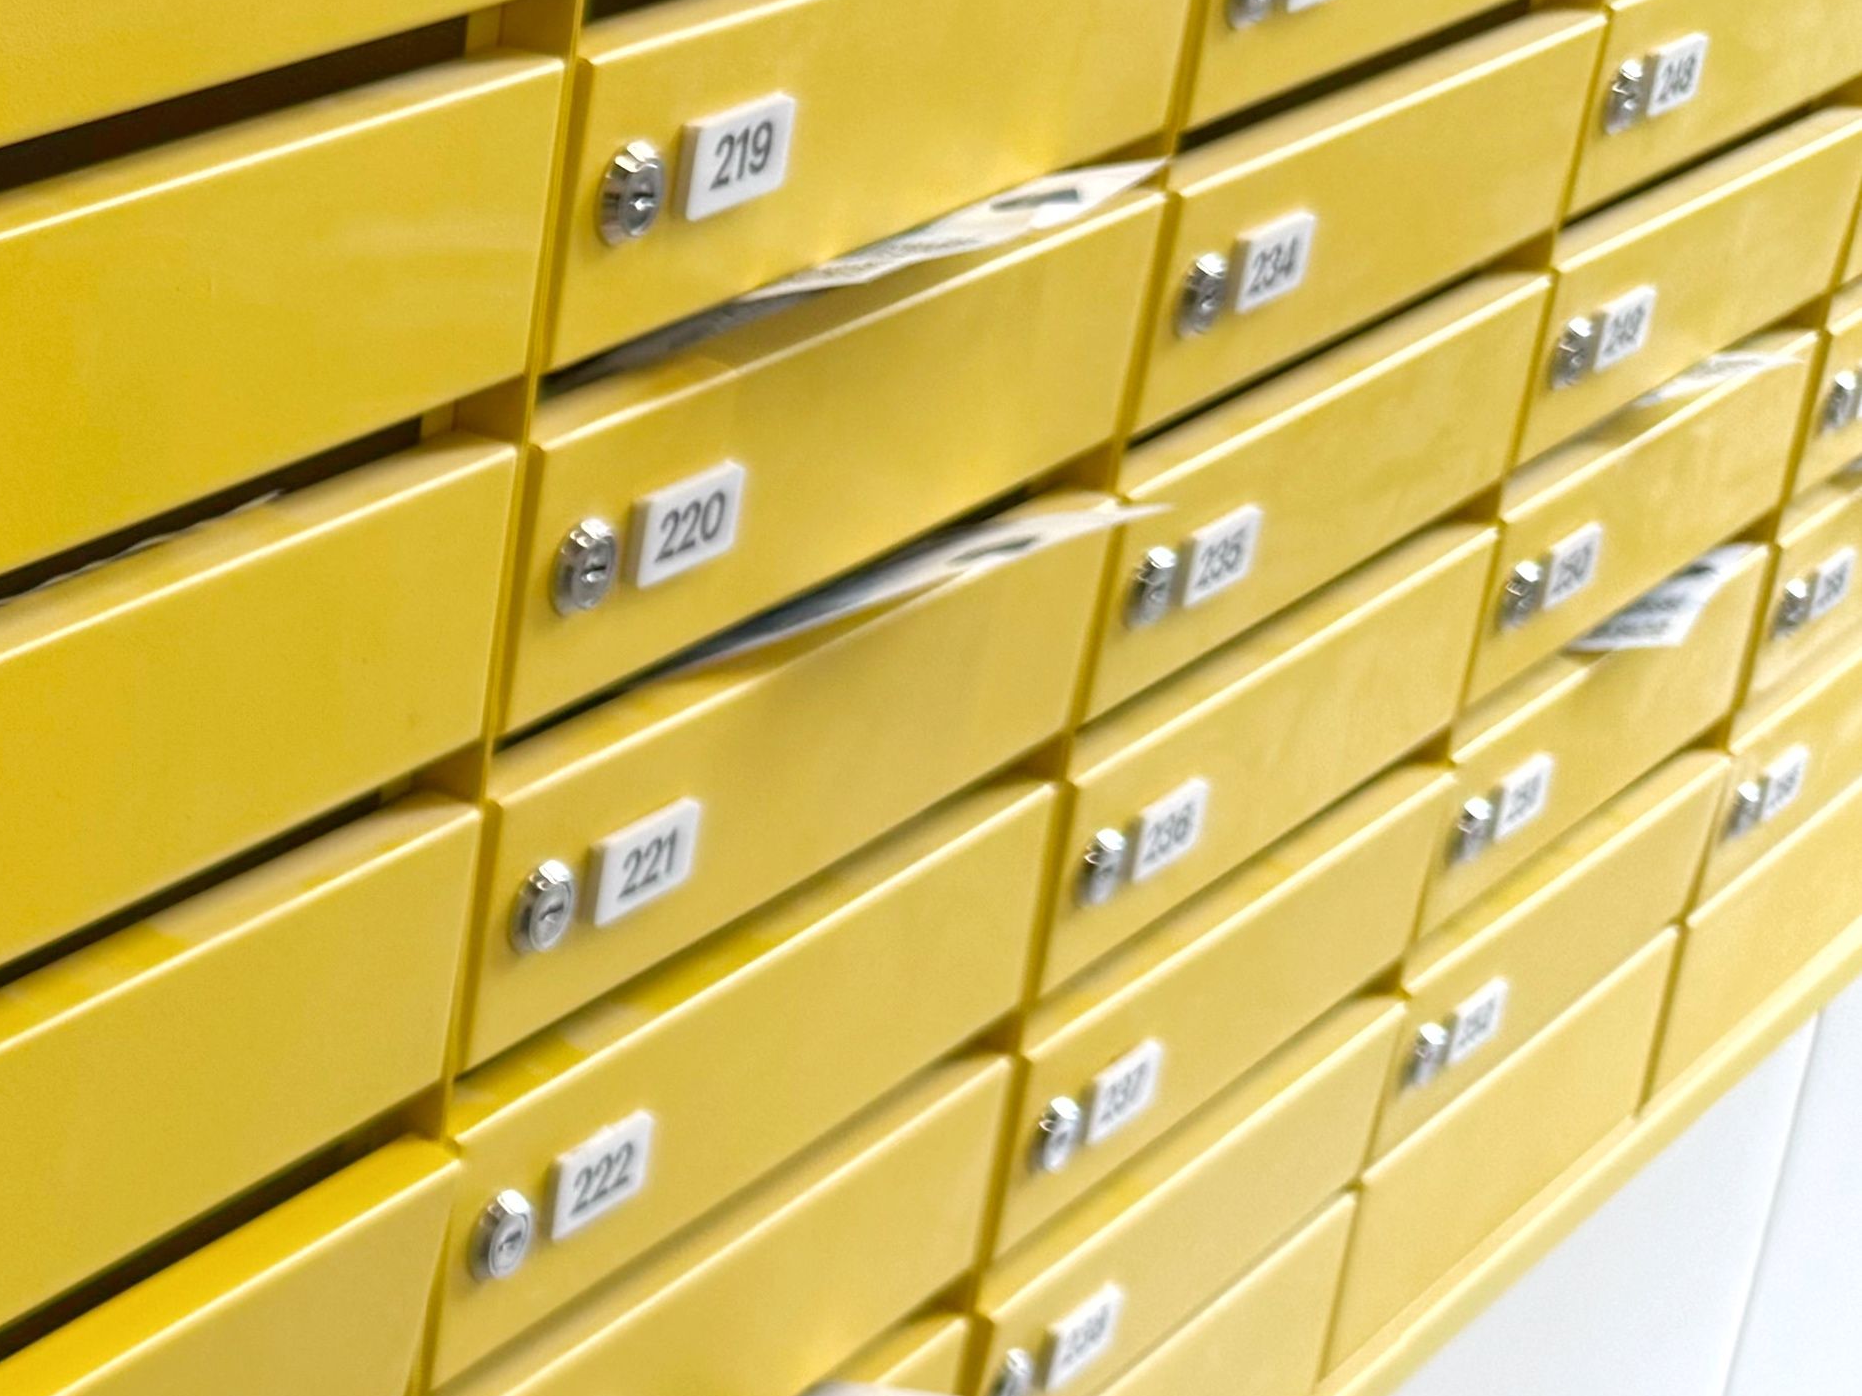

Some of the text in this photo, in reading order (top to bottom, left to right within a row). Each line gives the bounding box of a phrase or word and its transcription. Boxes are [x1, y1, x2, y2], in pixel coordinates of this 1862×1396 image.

[710, 119, 775, 190] 219
[1248, 238, 1299, 295] 234
[655, 490, 728, 563] 220
[619, 829, 678, 899] 221
[570, 1141, 635, 1215] 222
